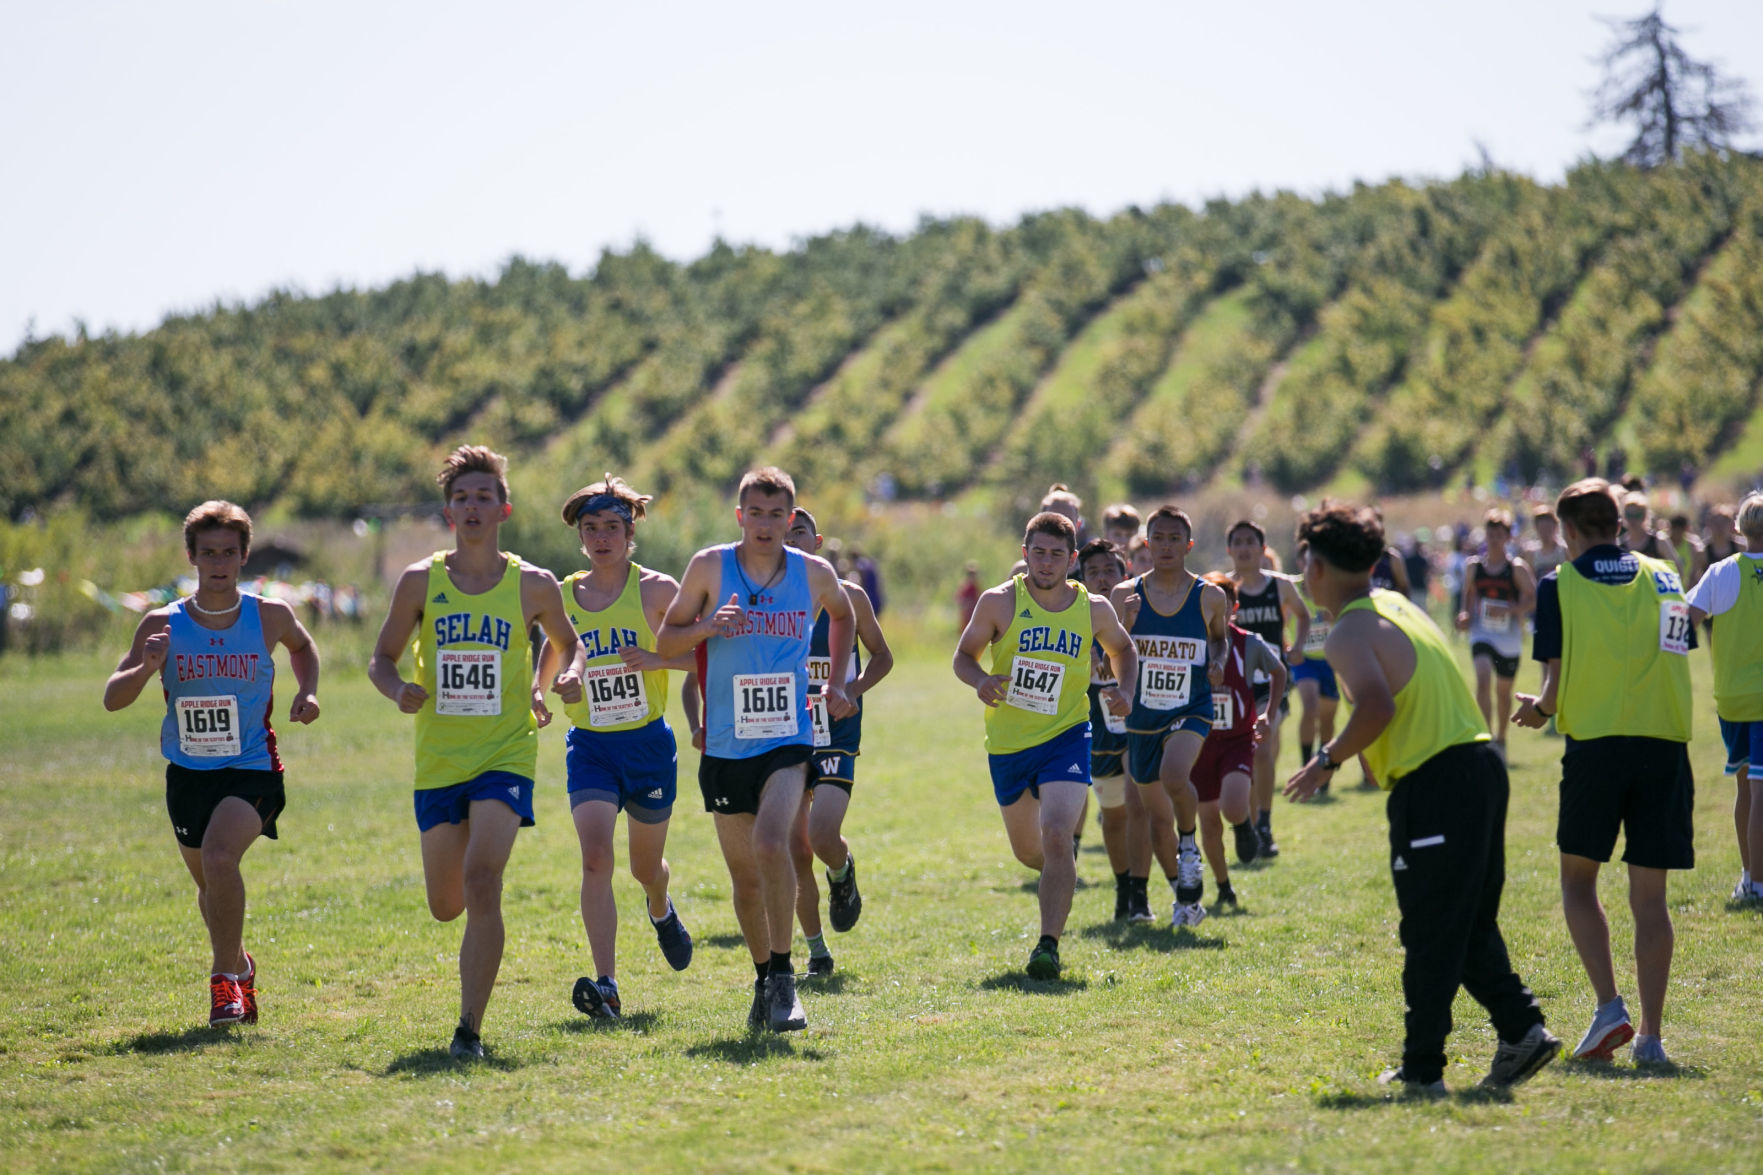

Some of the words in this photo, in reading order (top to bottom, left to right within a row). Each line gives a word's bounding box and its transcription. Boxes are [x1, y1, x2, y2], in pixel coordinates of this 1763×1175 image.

[1653, 571, 1680, 594] SE
[1236, 606, 1279, 625] ROYAL
[435, 613, 512, 651] SELAH
[579, 627, 638, 660] ELAH
[1018, 626, 1083, 659] SELAH
[442, 654, 461, 662] APPLE
[1136, 639, 1197, 660] WAPATO
[176, 654, 259, 683] EASTMONT
[587, 670, 605, 678] APPLE
[606, 667, 622, 676] RIDGE
[1018, 660, 1034, 668] APPLE
[441, 663, 495, 690] 1646
[760, 678, 777, 686] RIDGE
[778, 677, 790, 685] RUN
[1015, 667, 1059, 693] 1647
[1146, 670, 1186, 691] 1667
[589, 674, 640, 703] 1649
[742, 686, 788, 713] 1616
[181, 700, 199, 708] APPLE
[200, 700, 217, 708] RIDGE
[218, 699, 231, 707] RUN
[184, 708, 231, 733] 1619
[820, 756, 841, 775] W
